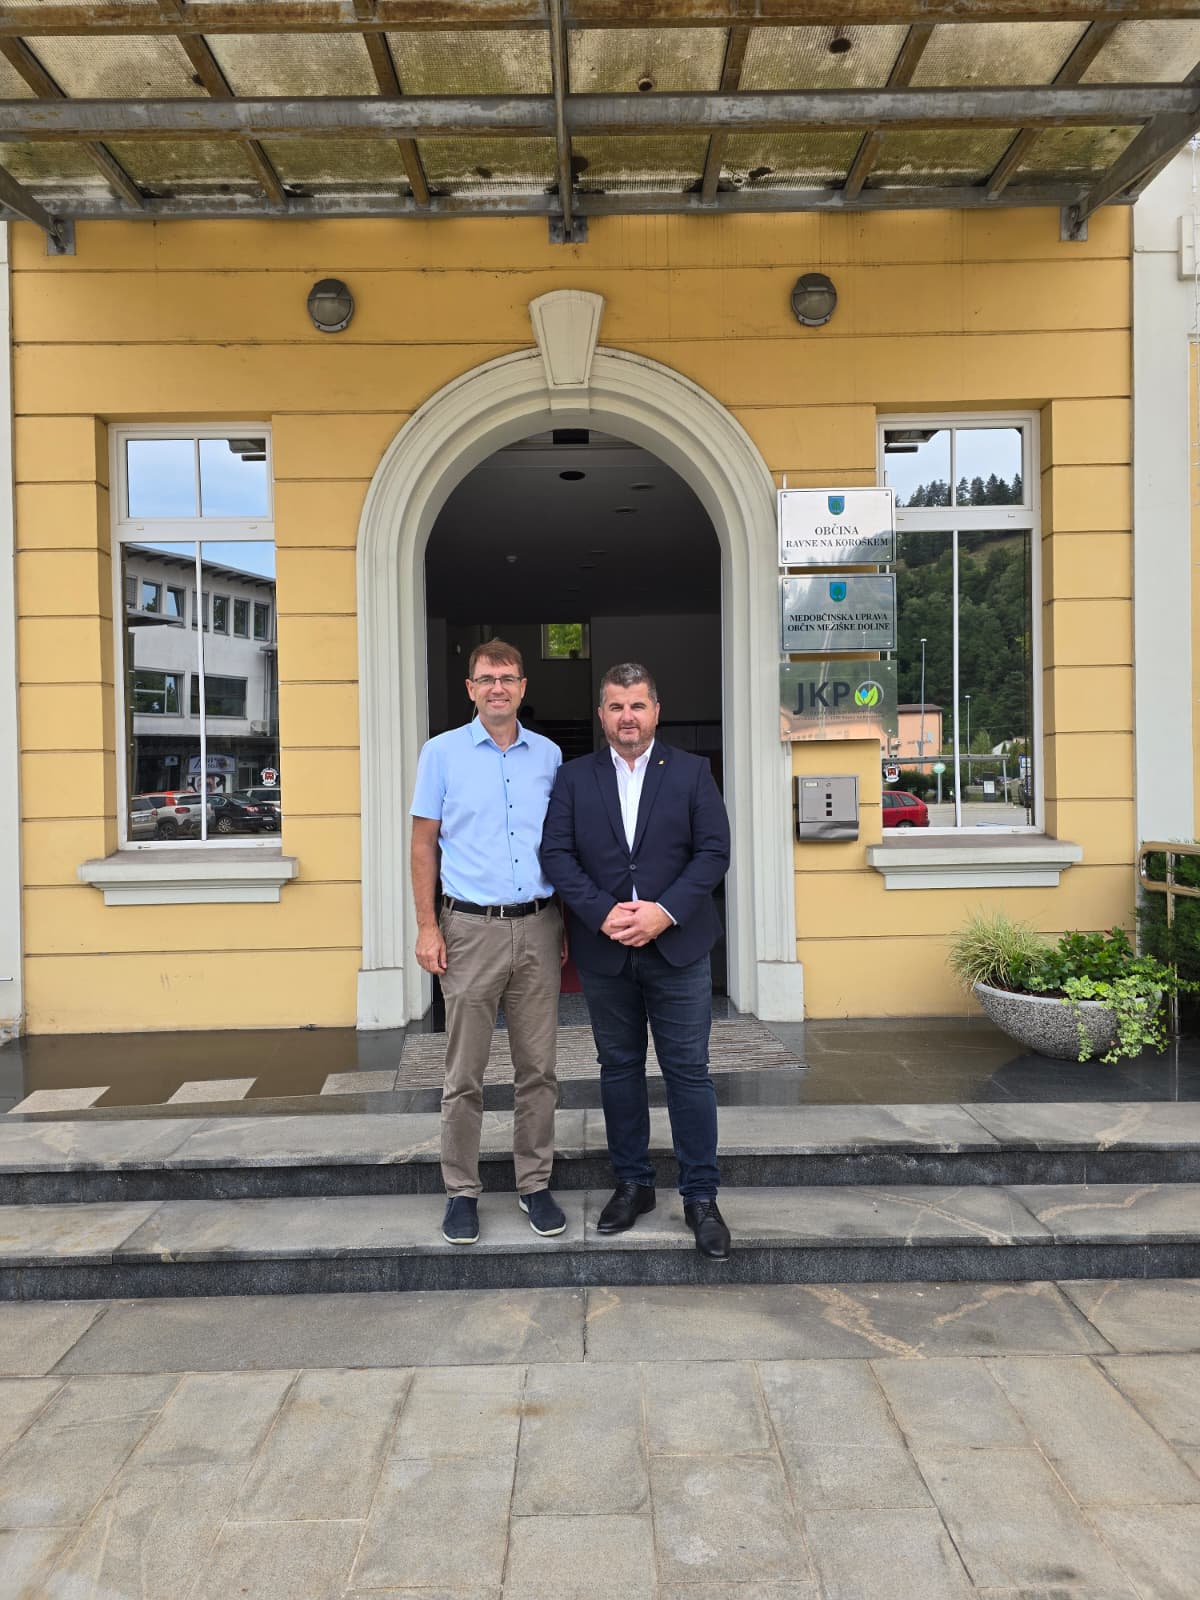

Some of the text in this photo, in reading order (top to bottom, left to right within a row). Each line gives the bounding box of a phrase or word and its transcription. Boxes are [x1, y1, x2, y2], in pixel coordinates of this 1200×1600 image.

[815, 523, 859, 535] OBČINA
[786, 539, 818, 548] RAVNE
[836, 537, 888, 547] KOROŠKEM
[790, 613, 888, 622] MEDOBČINSKA UPRAVA
[788, 622, 815, 631] OBČIN
[817, 621, 855, 631] MEŽIŠKE
[793, 681, 851, 715] JKP
